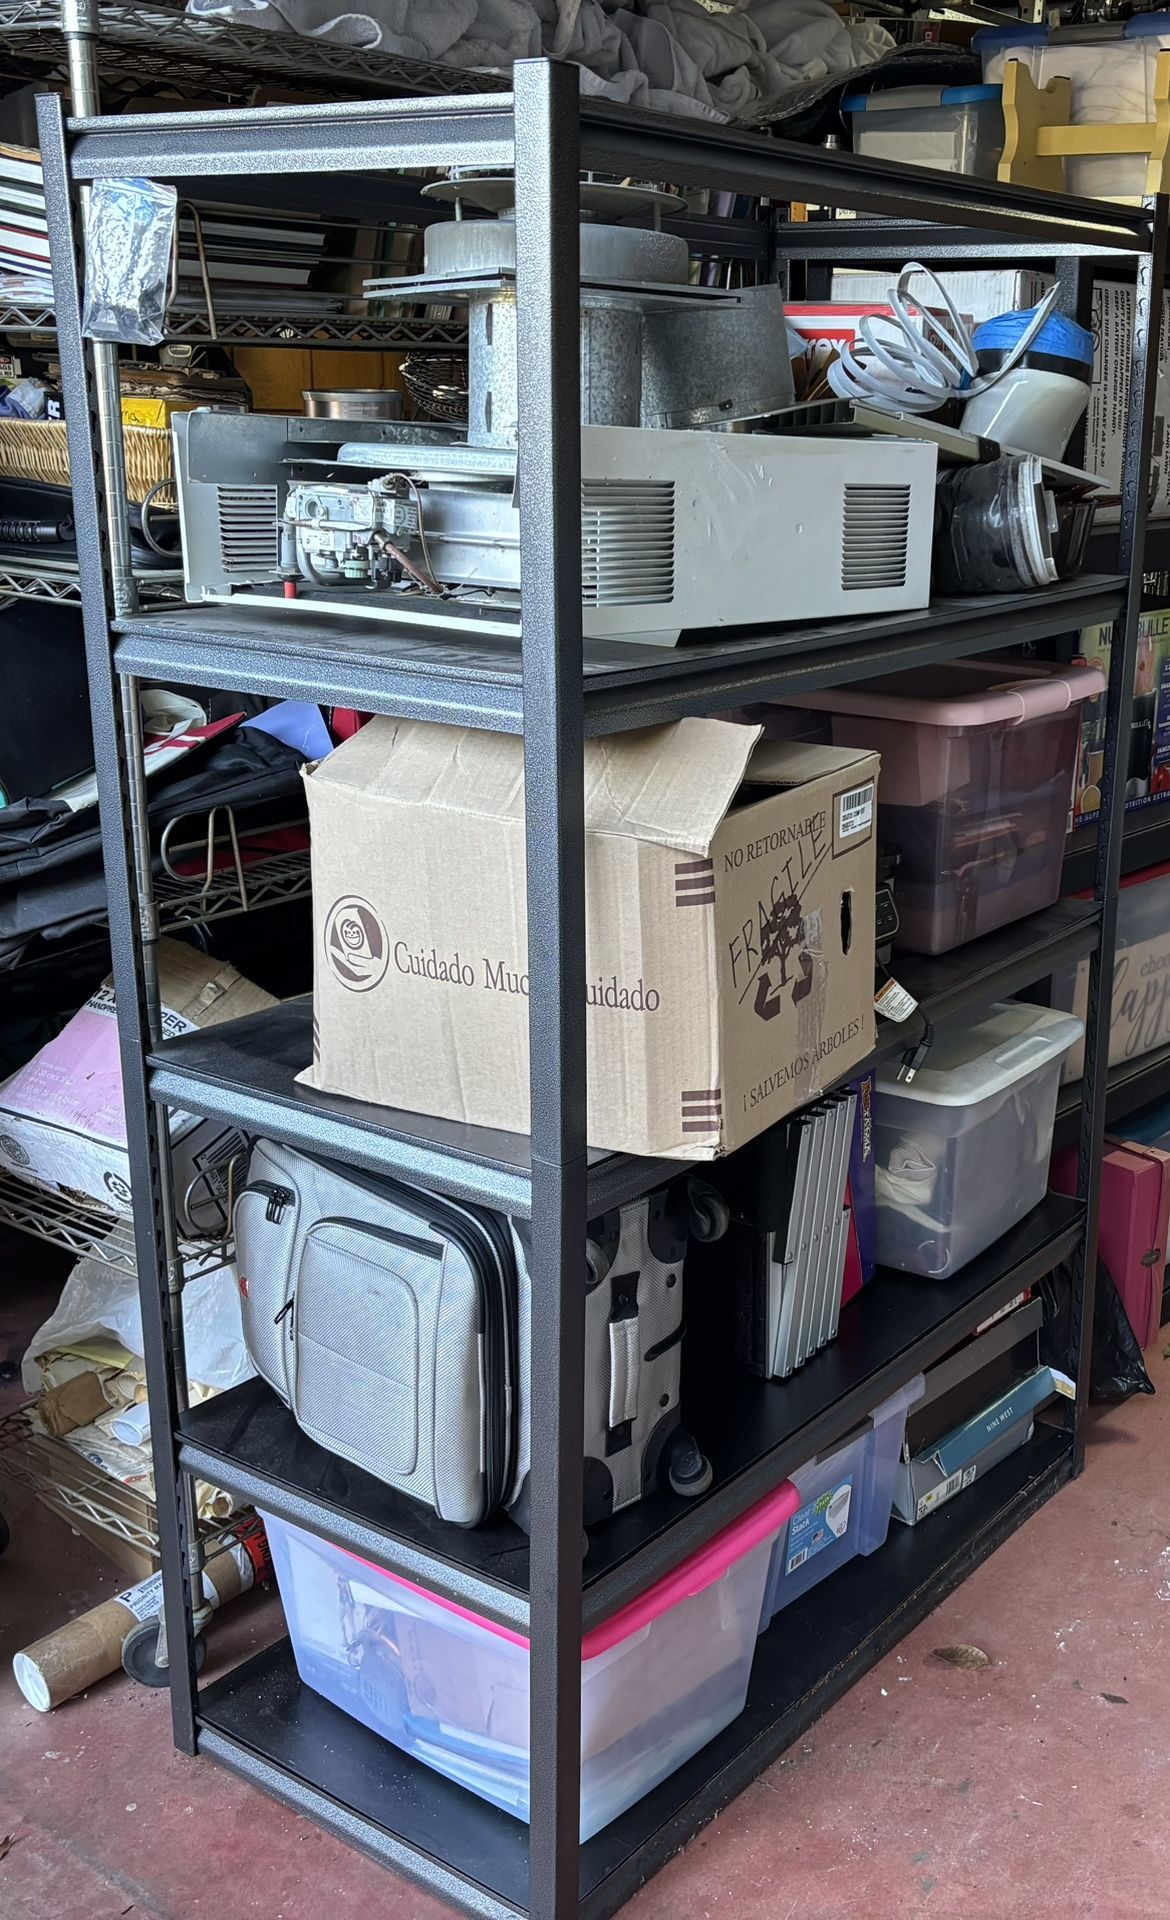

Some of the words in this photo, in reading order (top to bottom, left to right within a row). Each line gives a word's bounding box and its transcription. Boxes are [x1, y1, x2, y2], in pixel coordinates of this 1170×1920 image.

[724, 848, 744, 873] NO
[746, 810, 827, 863] RETORNABLE
[728, 811, 826, 988] FRAGILE
[394, 941, 475, 987] Cuidado
[482, 958, 530, 997] Muc
[586, 976, 660, 1012] uidado
[749, 1052, 809, 1108] SALVEMOS
[986, 1418, 1000, 1433] NINE
[999, 1406, 1014, 1422] WEST
[792, 1518, 810, 1536] Stack
